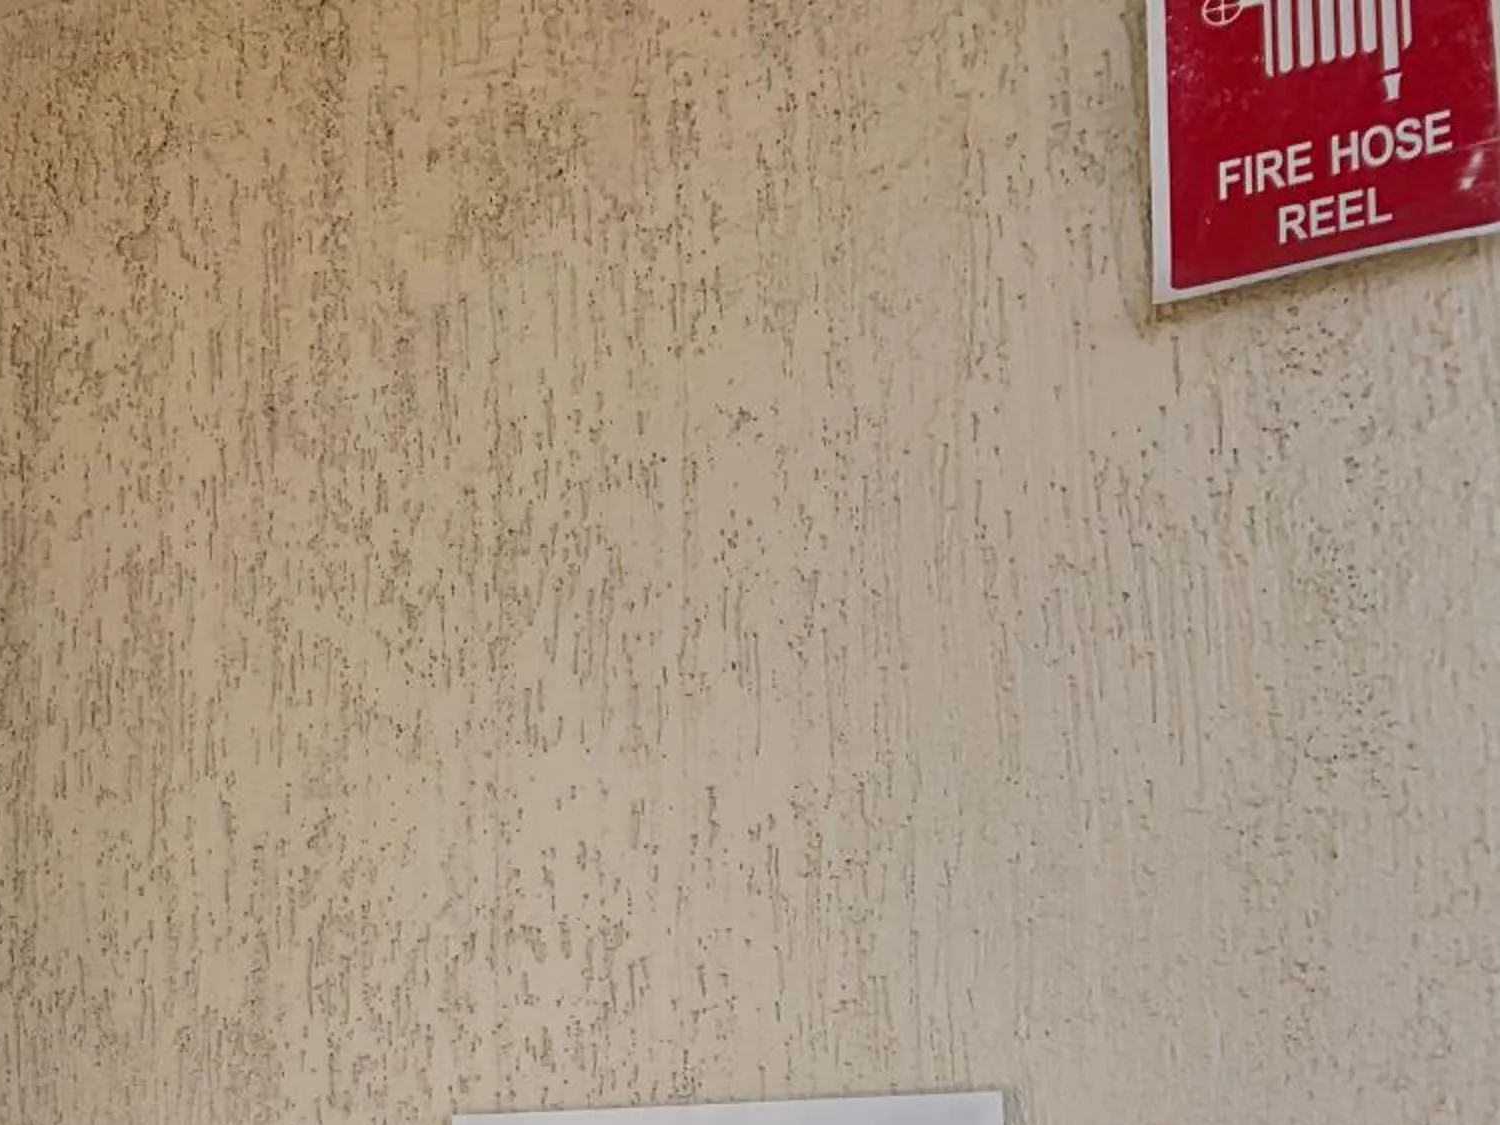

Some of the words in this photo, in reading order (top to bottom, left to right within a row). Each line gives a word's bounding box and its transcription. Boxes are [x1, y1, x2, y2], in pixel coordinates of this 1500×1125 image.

[1218, 141, 1313, 201] FIRE
[1330, 109, 1453, 175] HOSE
[1278, 187, 1393, 246] REEL
